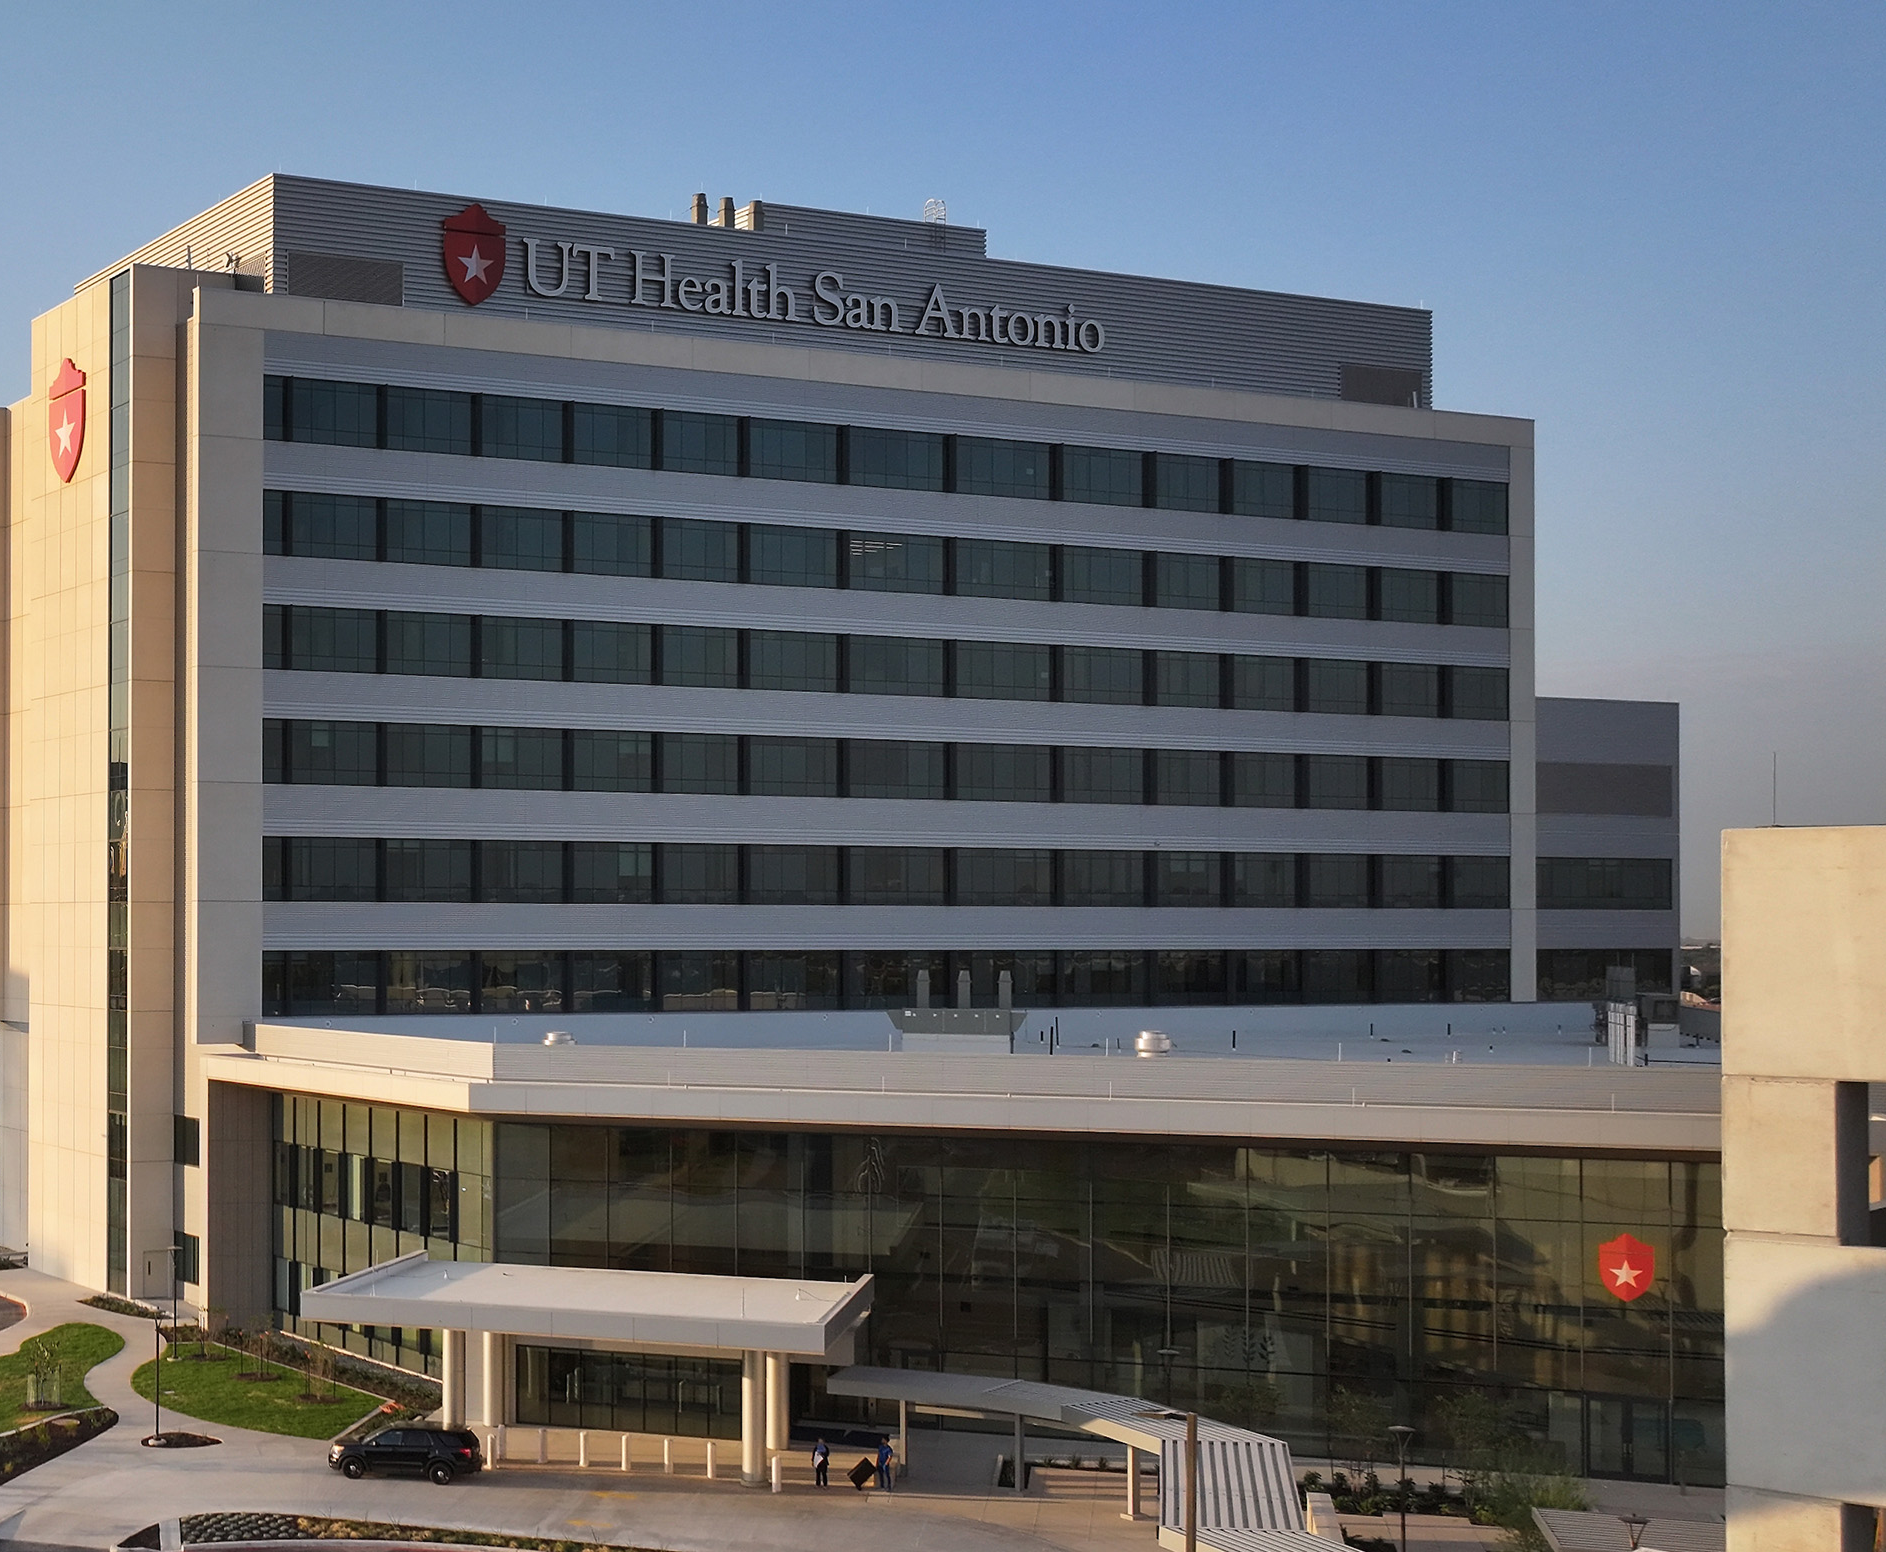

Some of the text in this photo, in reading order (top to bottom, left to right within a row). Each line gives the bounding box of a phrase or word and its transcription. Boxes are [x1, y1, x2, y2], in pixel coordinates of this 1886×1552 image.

[522, 237, 1106, 353] UT Health San Antonio
